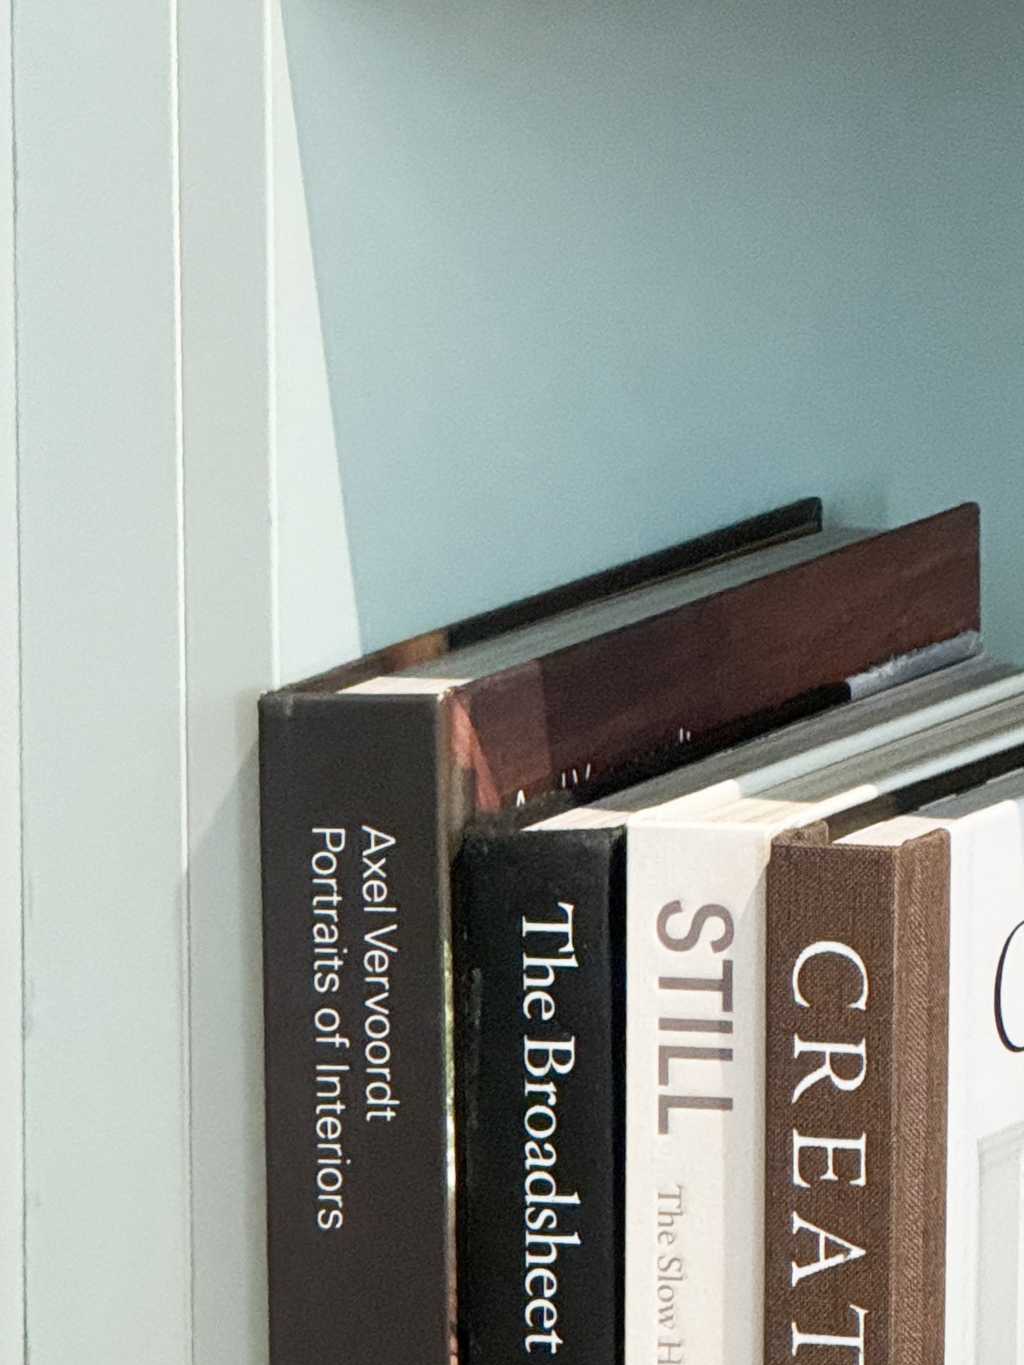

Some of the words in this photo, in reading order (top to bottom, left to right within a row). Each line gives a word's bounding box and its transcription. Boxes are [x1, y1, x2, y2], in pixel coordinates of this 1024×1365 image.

[311, 827, 346, 993] Portraits
[361, 825, 397, 913] Axel
[314, 1007, 350, 1049] of
[363, 923, 401, 1122] Vervoordt
[522, 901, 579, 1021] The
[656, 899, 735, 1135] STILL
[315, 1064, 350, 1230] Interiors
[523, 1035, 582, 1354] Broadsheet
[657, 1183, 684, 1245] The
[657, 1255, 684, 1332] Slow
